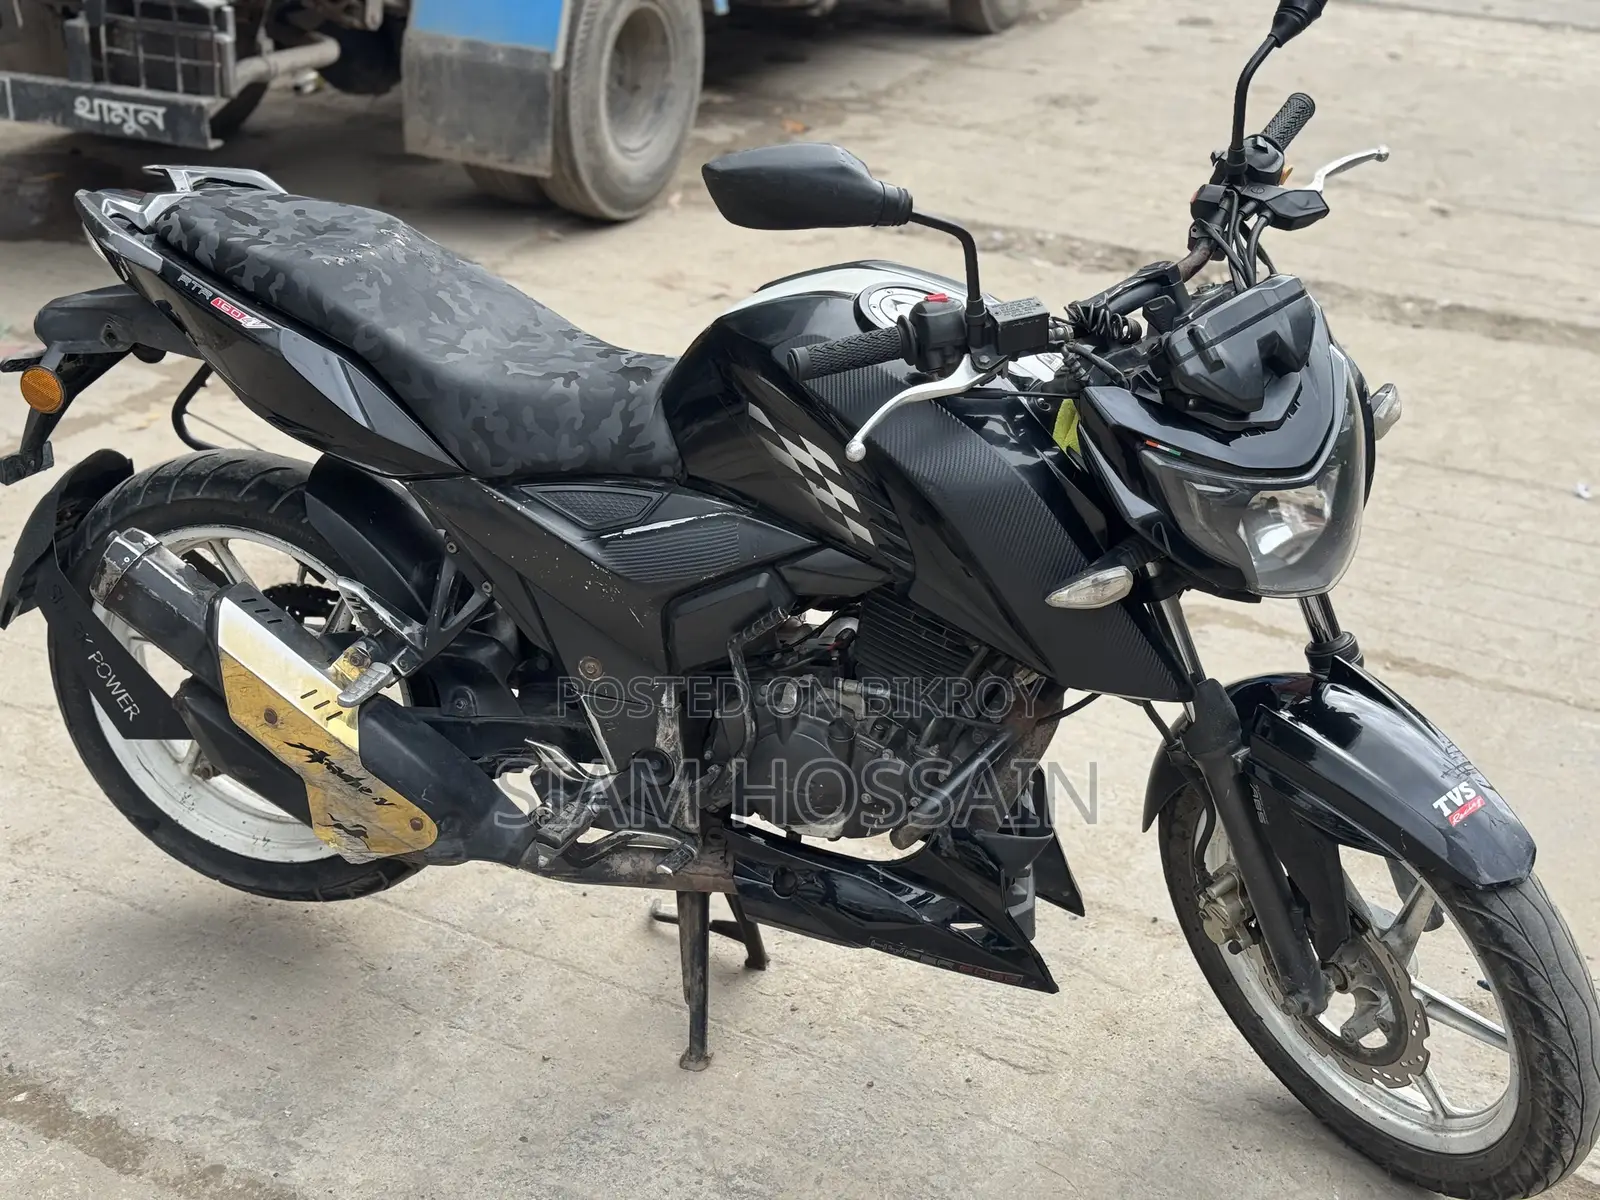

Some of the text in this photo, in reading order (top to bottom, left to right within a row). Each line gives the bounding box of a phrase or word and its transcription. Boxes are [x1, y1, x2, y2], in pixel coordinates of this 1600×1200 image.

[74, 96, 166, 137] থামুন
[178, 273, 213, 300] RTR
[88, 651, 140, 721] POWER
[1433, 781, 1476, 817] TVS
